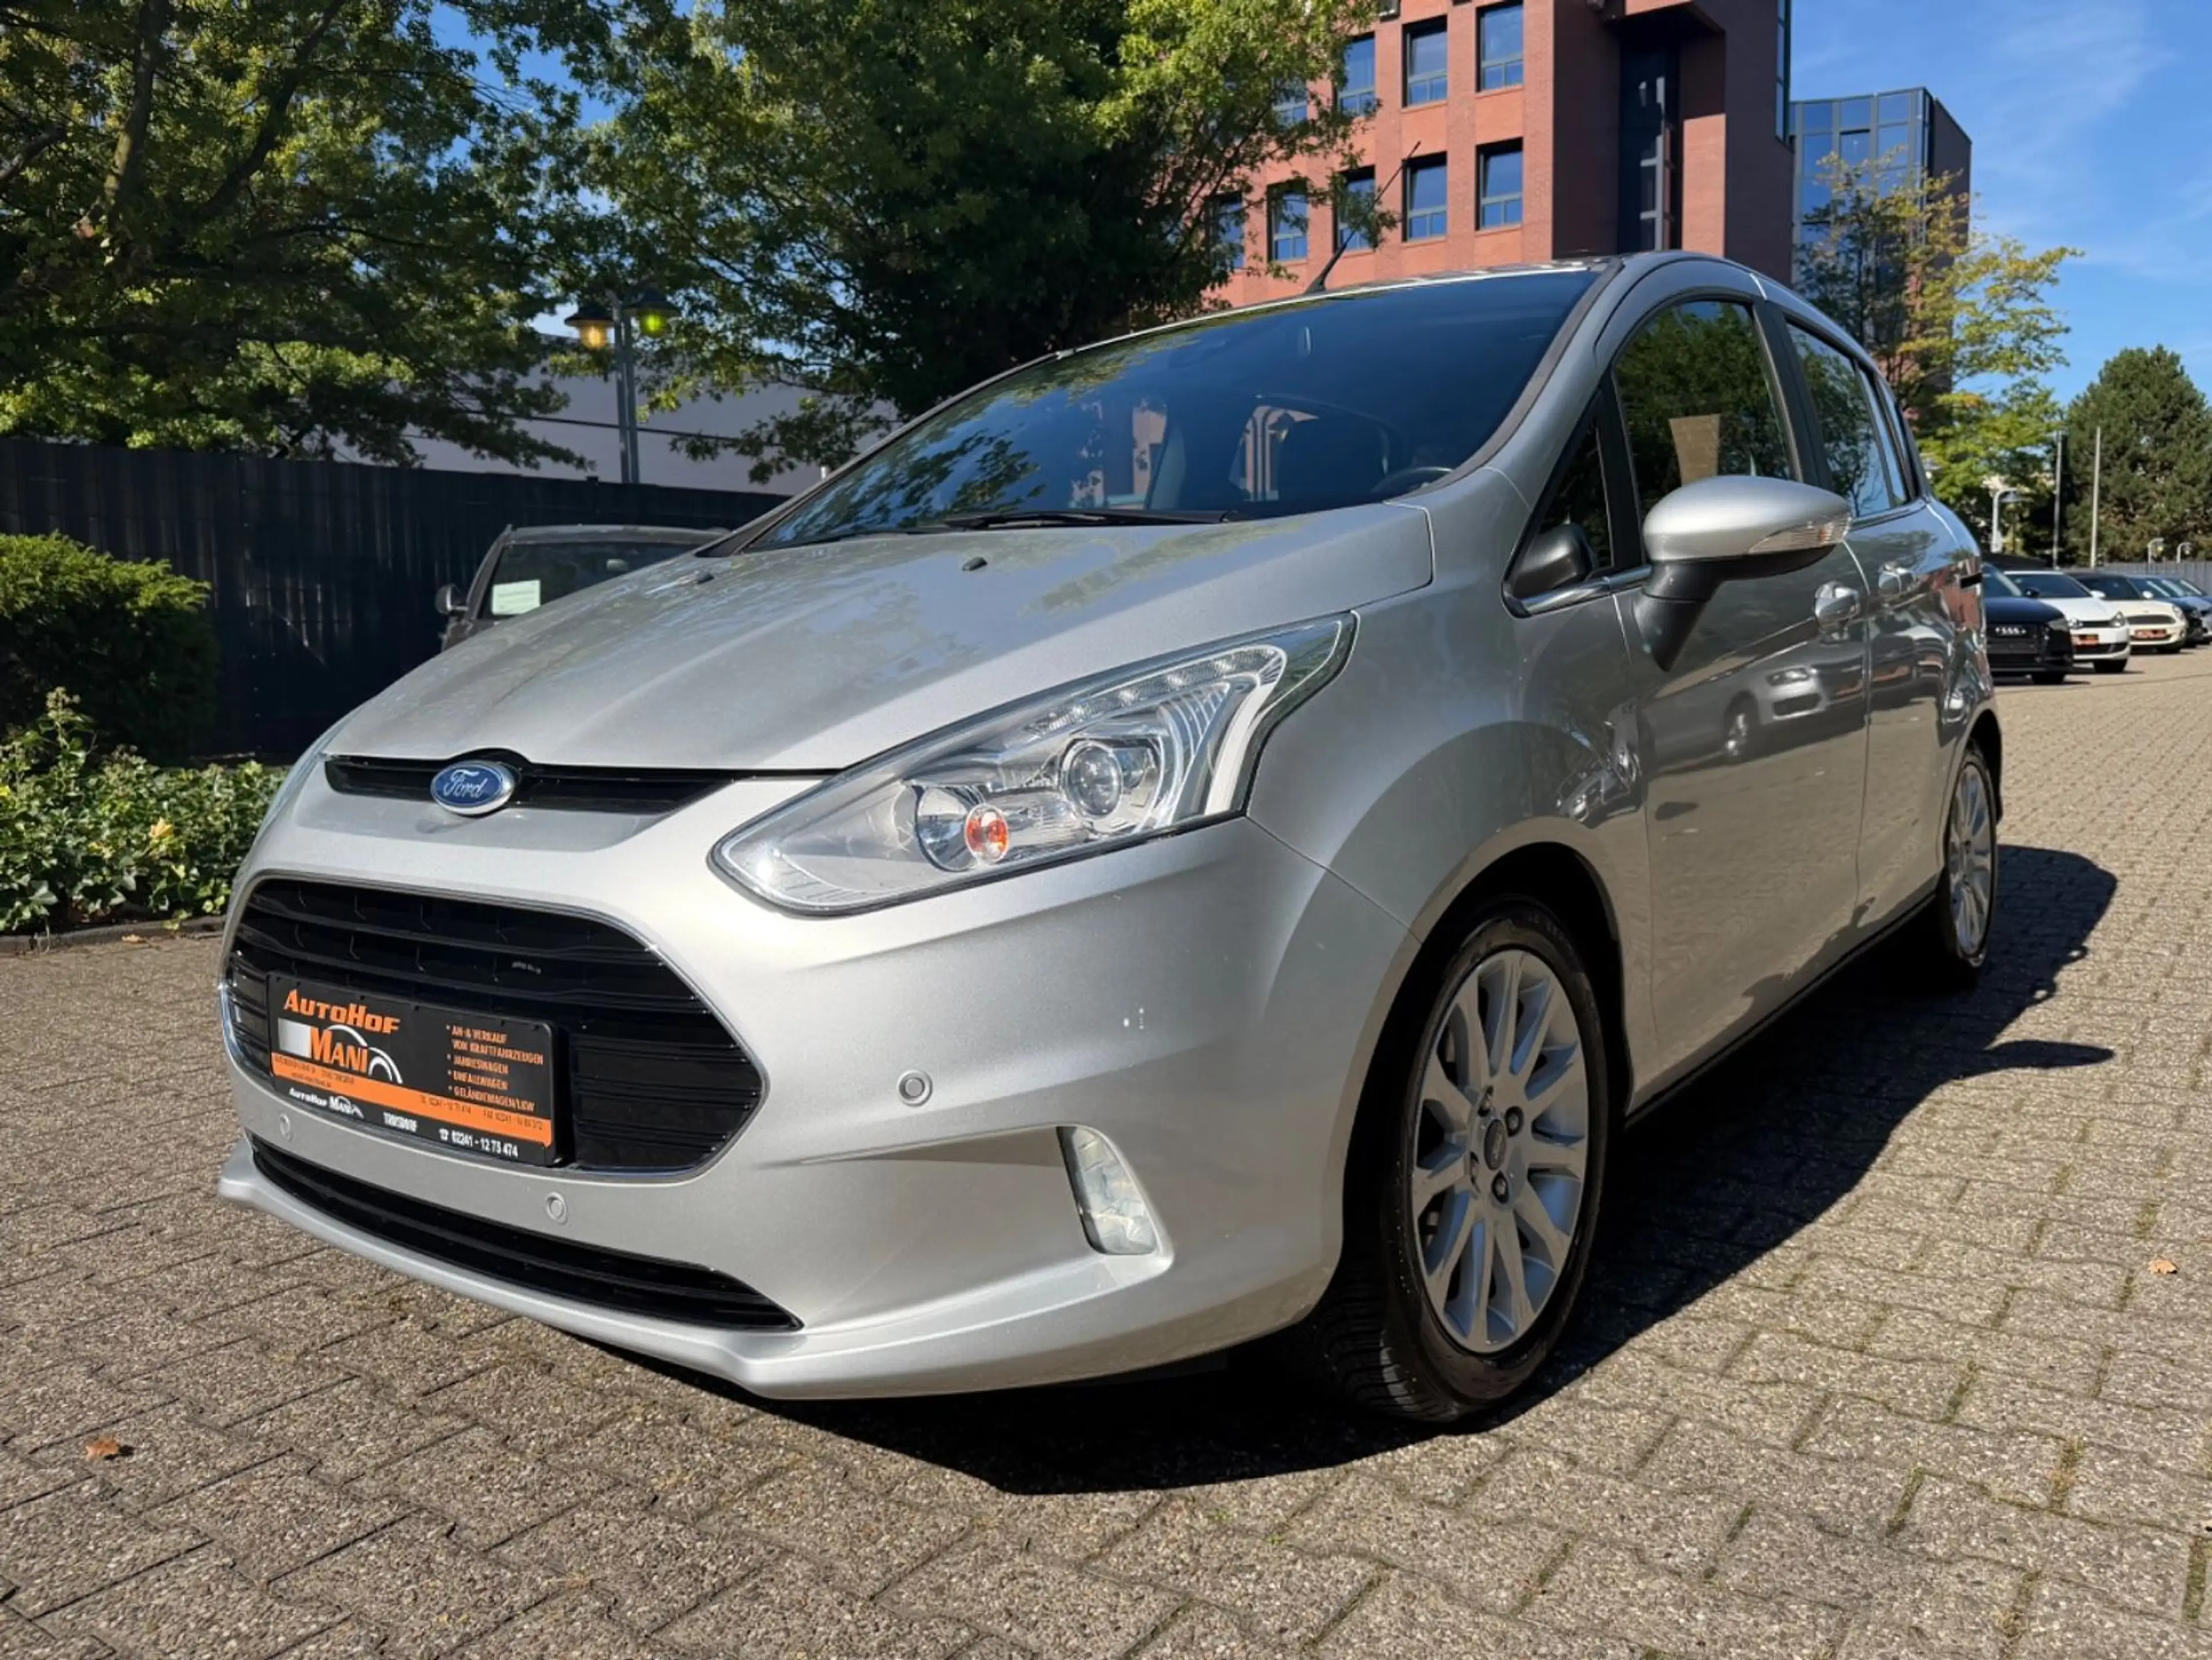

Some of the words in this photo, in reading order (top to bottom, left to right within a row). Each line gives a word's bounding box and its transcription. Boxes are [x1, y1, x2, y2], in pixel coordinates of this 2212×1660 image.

[443, 769, 488, 798] Ford
[310, 1025, 368, 1073] MANI
[472, 1029, 508, 1044] VERKAUF
[469, 1042, 544, 1065] KRAFTFAHRZEUGEN
